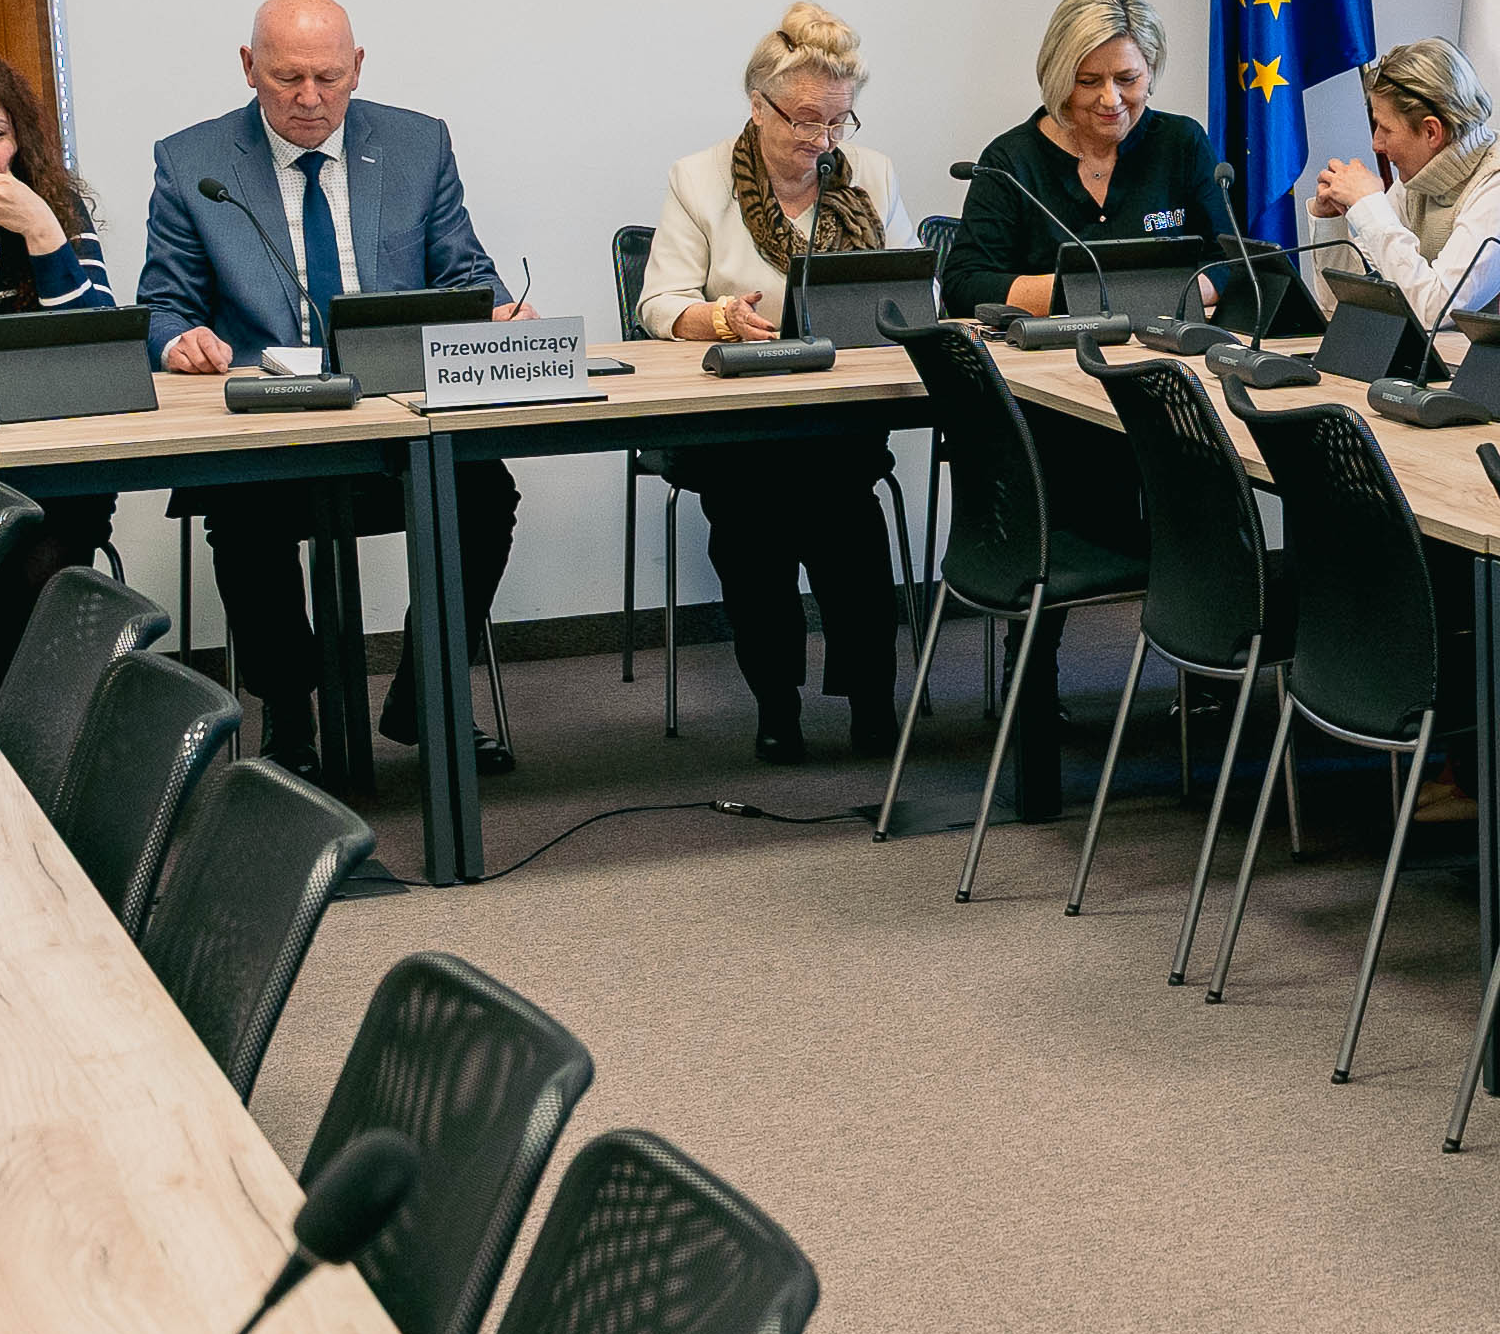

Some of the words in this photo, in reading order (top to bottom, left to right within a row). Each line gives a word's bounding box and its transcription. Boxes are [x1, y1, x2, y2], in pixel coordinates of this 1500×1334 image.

[429, 333, 579, 359] Przewodniczący
[756, 347, 801, 359] VISSONIC
[437, 365, 485, 386] Rady
[490, 359, 575, 383] Miejskiej
[264, 385, 314, 395] VISSONIC
